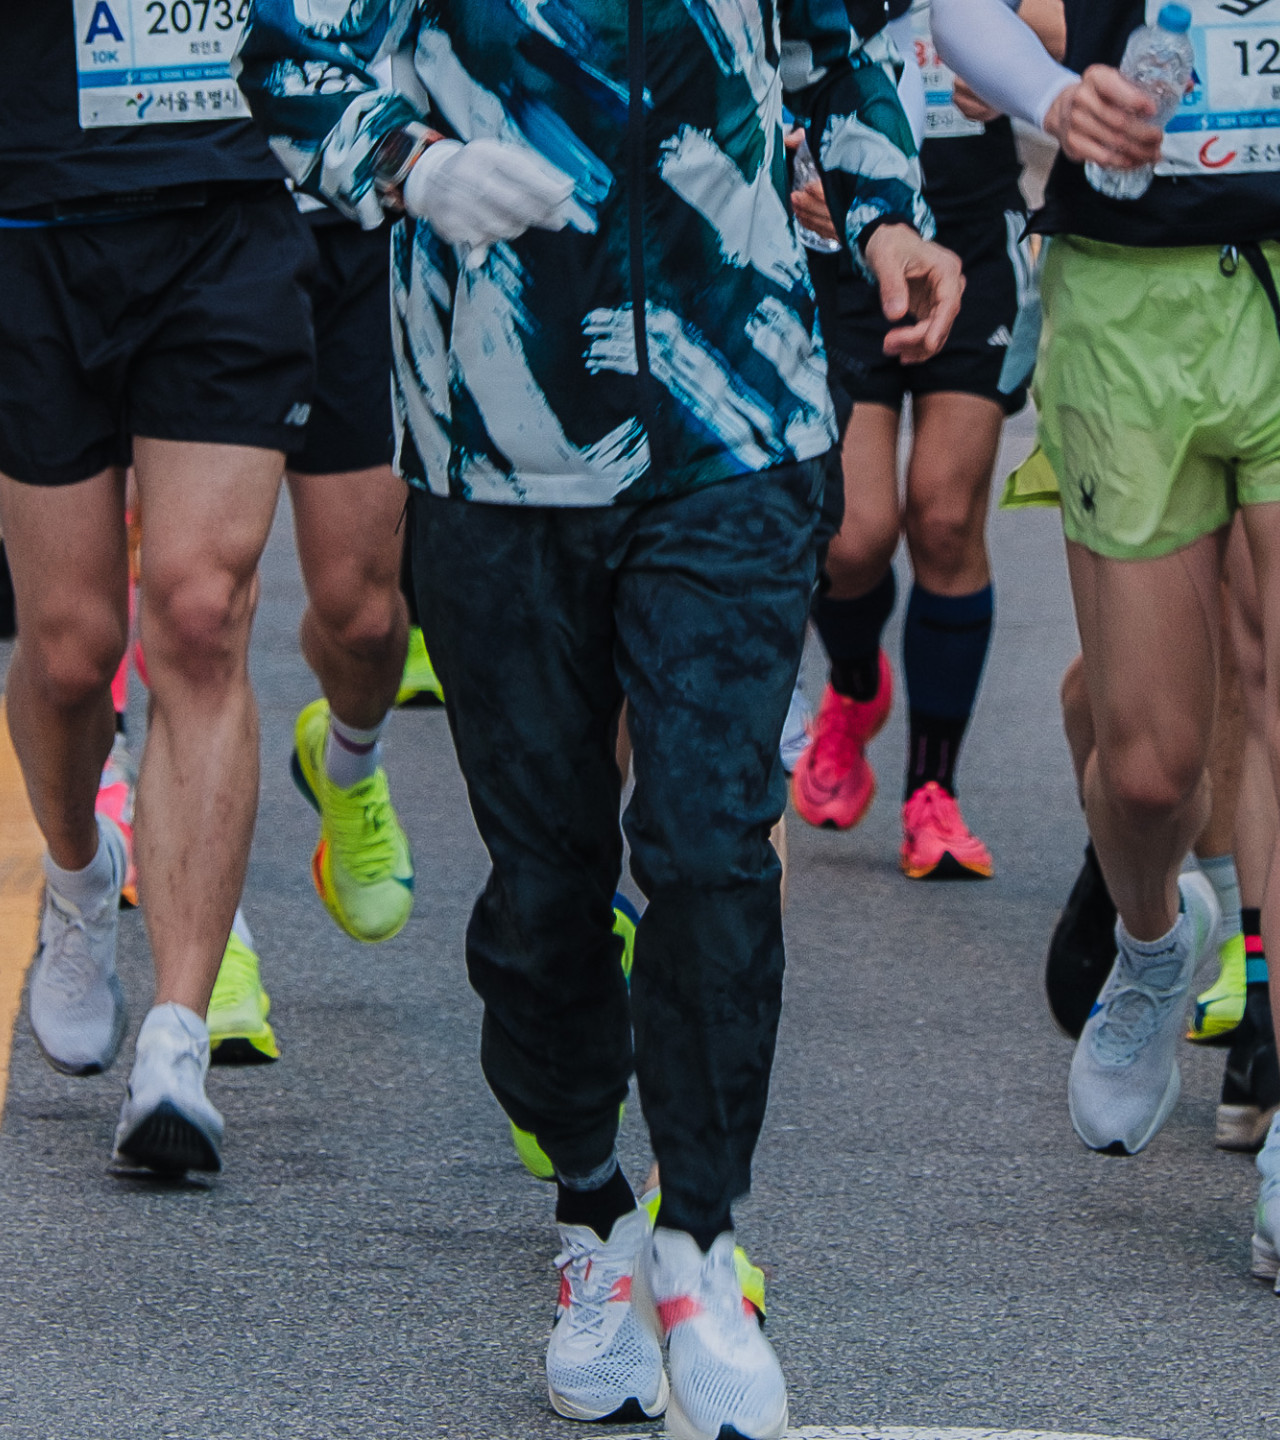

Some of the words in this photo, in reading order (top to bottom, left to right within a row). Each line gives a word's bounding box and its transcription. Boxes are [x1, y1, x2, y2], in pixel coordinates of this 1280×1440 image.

[85, 0, 124, 44] A
[91, 50, 120, 64] 10K
[156, 88, 238, 112] 서울특별시
